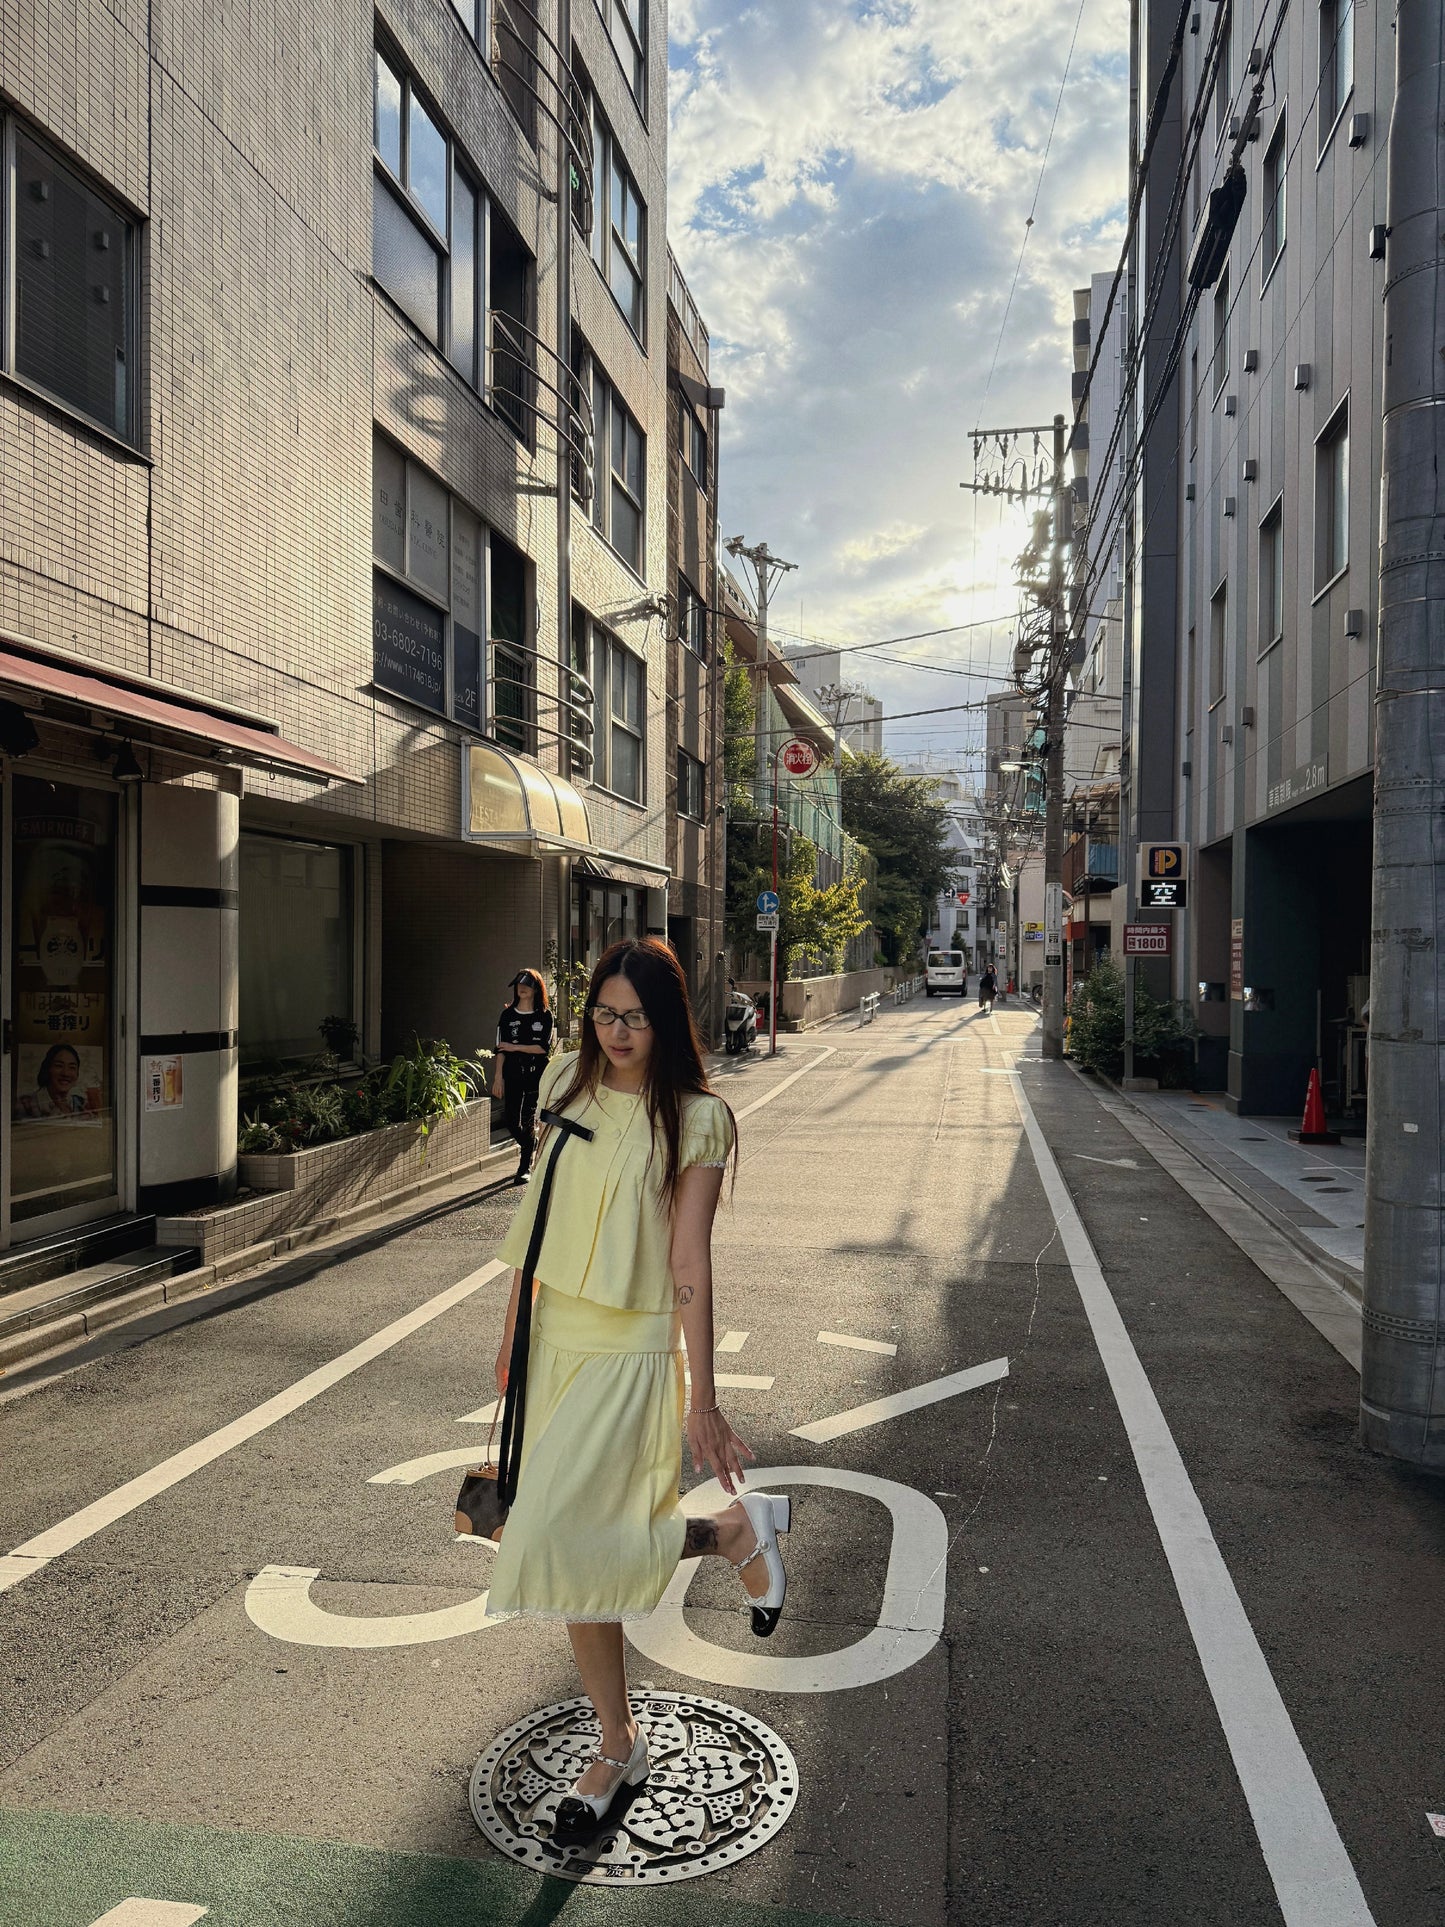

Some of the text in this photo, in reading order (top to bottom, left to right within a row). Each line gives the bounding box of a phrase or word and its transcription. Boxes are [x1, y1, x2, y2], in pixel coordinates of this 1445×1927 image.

[375, 619, 442, 671] 03-6802-7196
[465, 688, 476, 708] 2F
[786, 753, 812, 765] 消火栓
[1305, 764, 1325, 791] 2.8m
[21, 820, 89, 840] SMIRNOFF
[1150, 882, 1177, 906] 空
[1136, 938, 1164, 949] 1800
[33, 1015, 90, 1031] 一番搾り
[152, 1074, 161, 1103] 一番搾り
[649, 1702, 674, 1712] T-20
[578, 1862, 624, 1877] 合流
